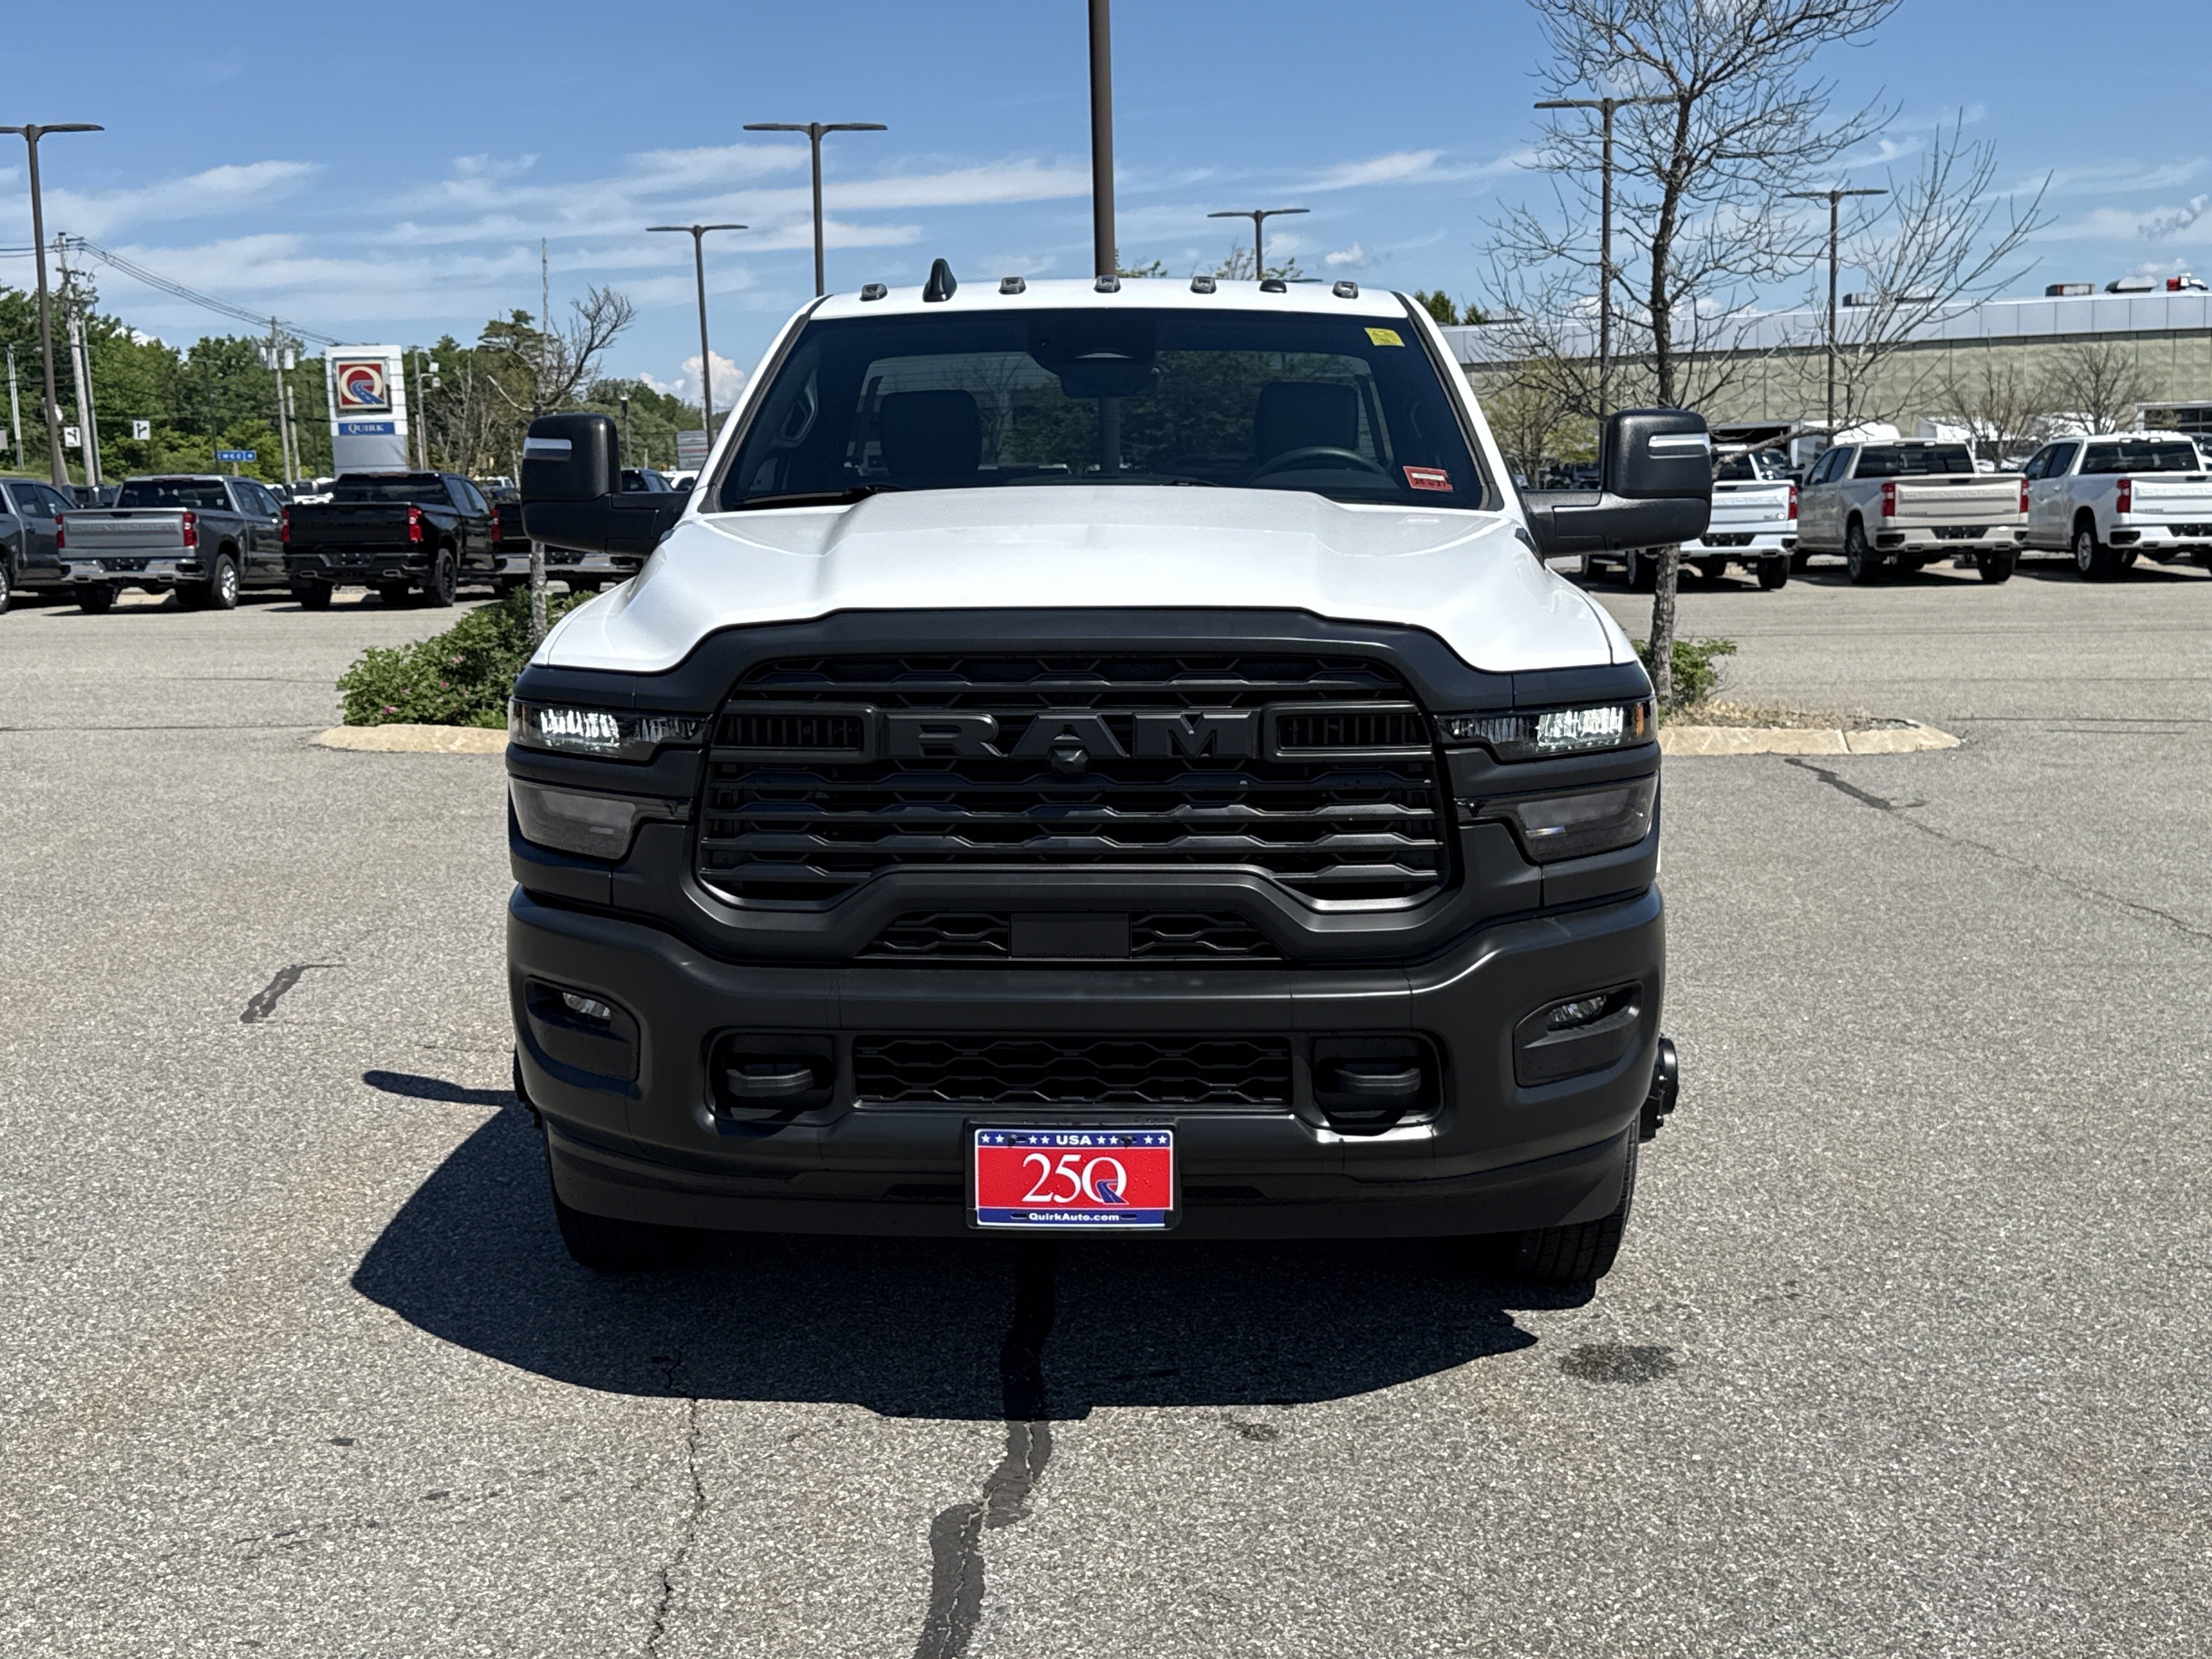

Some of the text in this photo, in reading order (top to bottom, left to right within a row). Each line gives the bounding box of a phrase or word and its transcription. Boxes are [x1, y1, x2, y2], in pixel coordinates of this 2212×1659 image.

[348, 424, 385, 434] QUIRK
[885, 712, 1252, 759] RAM
[1056, 1136, 1092, 1146] USA
[1029, 1213, 1120, 1221] QuirkAuto.com
